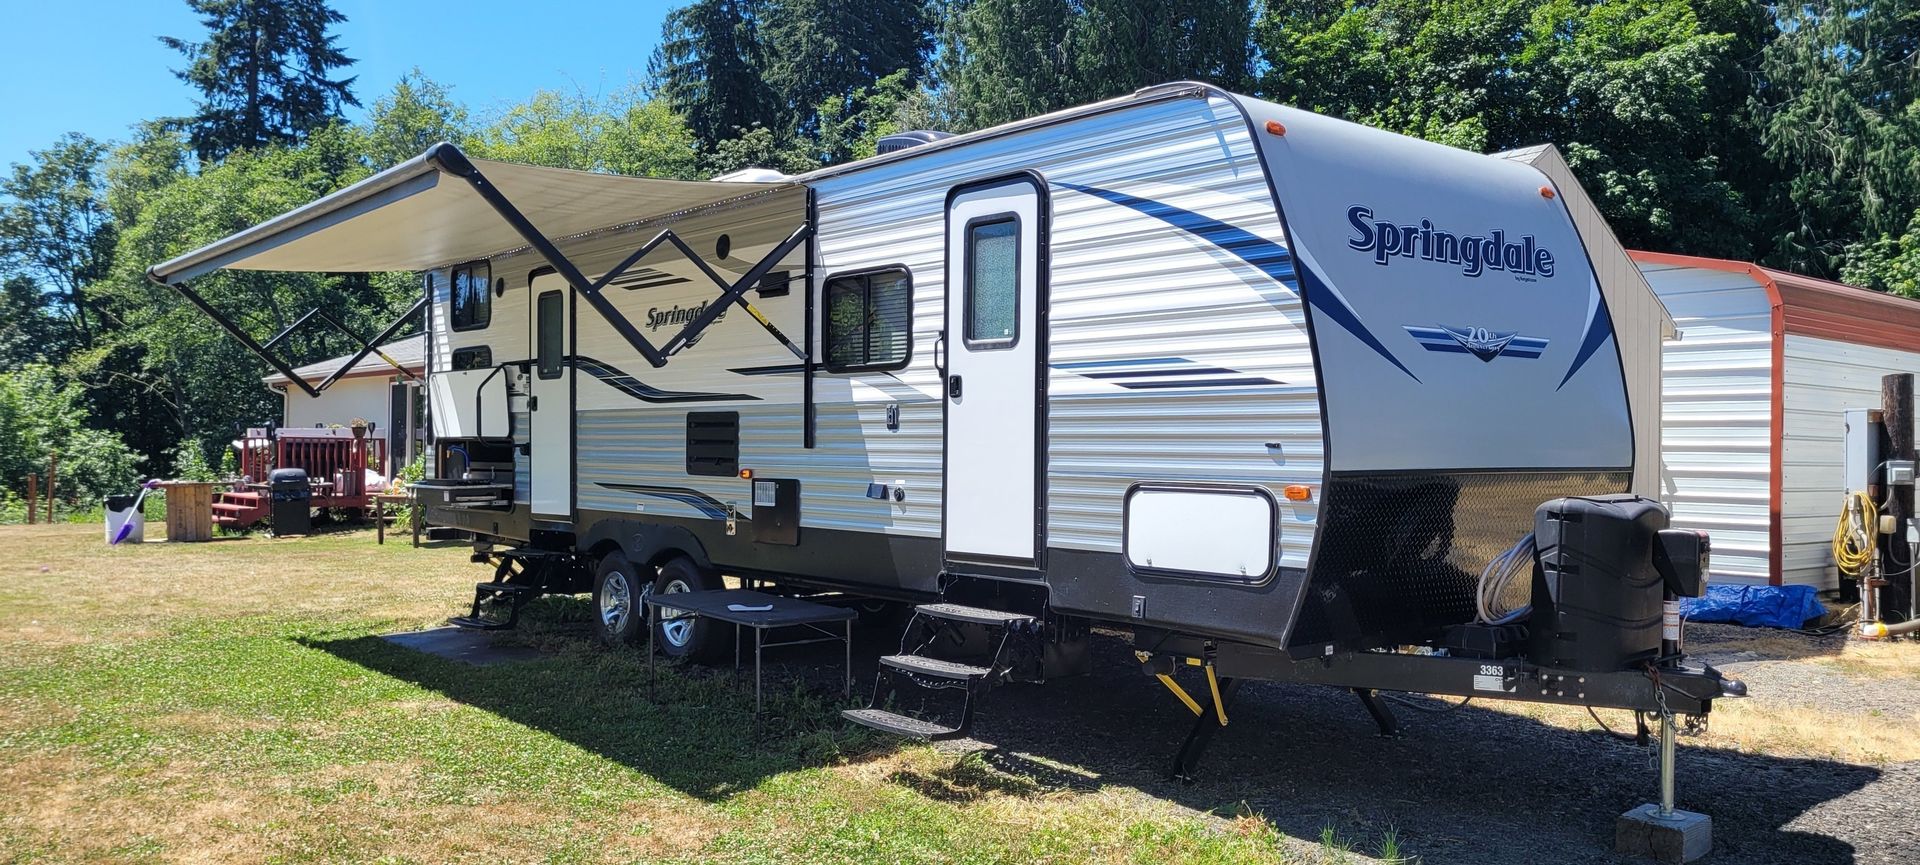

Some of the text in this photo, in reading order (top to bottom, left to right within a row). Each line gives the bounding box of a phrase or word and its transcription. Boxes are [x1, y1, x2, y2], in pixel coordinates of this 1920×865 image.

[1346, 204, 1555, 277] Springdale
[1465, 326, 1497, 343] 20th
[1480, 664, 1504, 676] 3363
